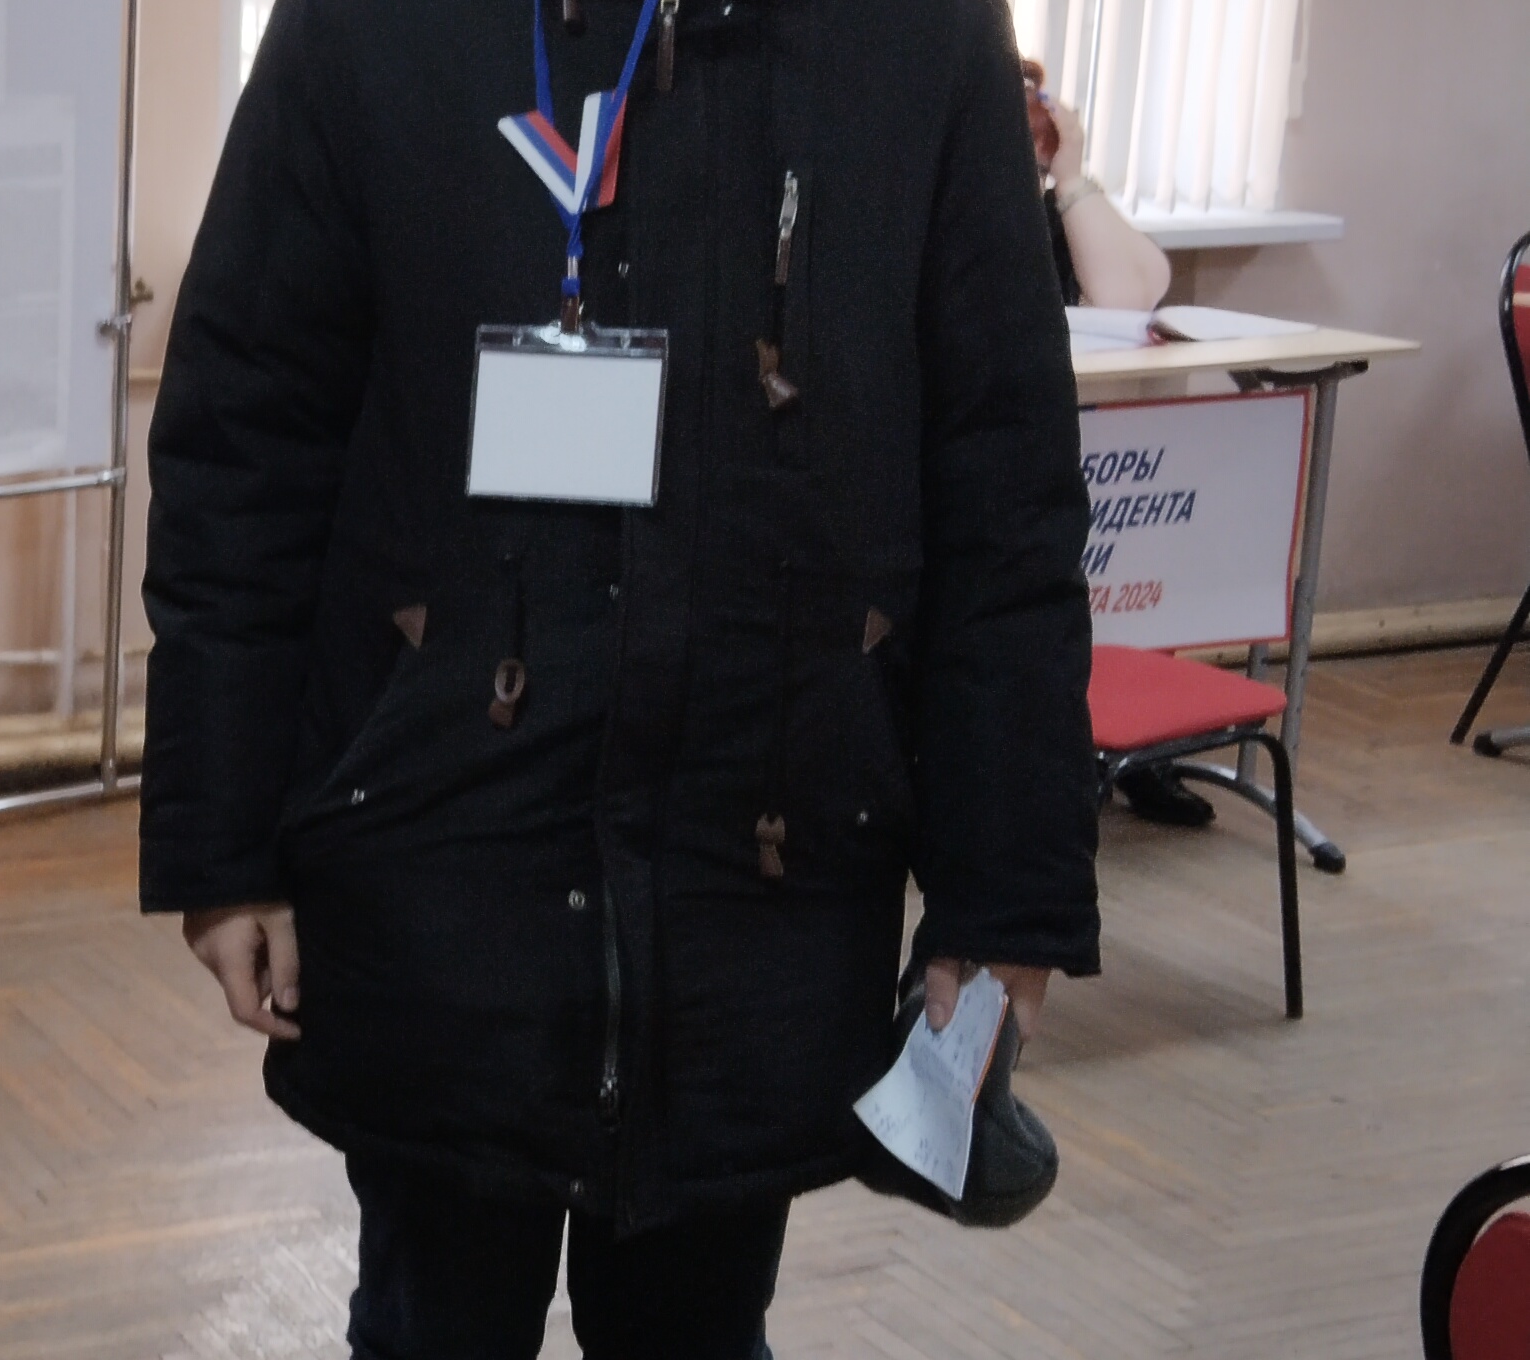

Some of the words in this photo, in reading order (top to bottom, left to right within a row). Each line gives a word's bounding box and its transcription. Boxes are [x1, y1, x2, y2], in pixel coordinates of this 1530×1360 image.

[1081, 446, 1165, 486] БОРЫ
[1091, 490, 1197, 536] ИДЕНТА
[1111, 580, 1163, 614] 2024
